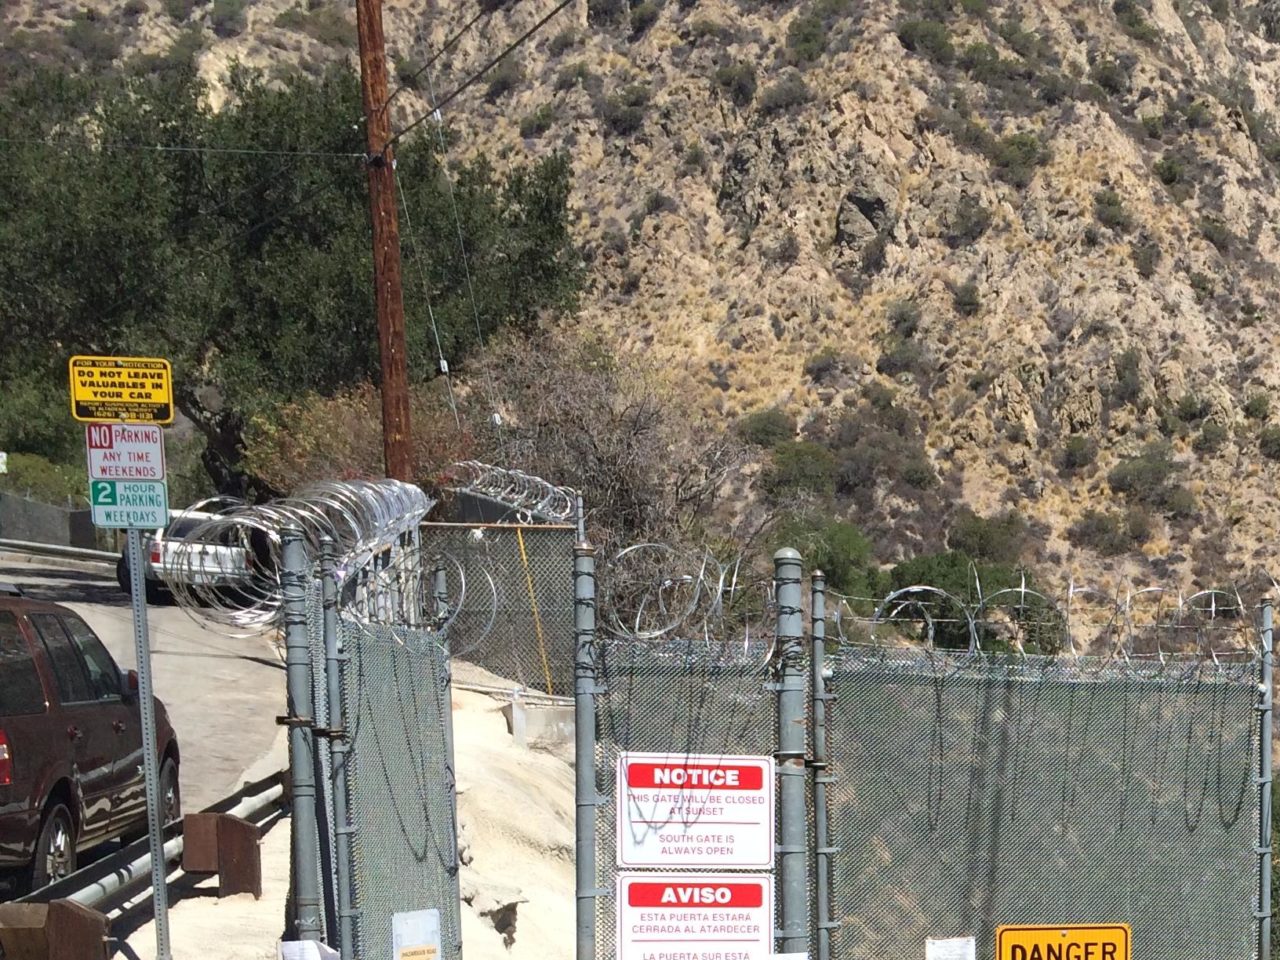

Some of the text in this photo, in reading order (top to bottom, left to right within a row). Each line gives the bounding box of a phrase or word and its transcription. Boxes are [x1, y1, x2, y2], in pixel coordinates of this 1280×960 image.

[78, 370, 94, 378] DO
[80, 381, 146, 389] VALUABLES
[90, 427, 158, 448] NO PARKING
[102, 452, 151, 462] ANY TIME
[100, 466, 156, 477] WEEKENDS
[98, 483, 155, 502] 2 HOUR
[120, 494, 162, 507] PARKING
[104, 510, 157, 523] WEEKDAYS
[654, 768, 740, 786] NOTICE
[628, 794, 765, 804] THIS GATE WILL BE CLOSED
[659, 835, 734, 843] SOUTH GATE IS
[661, 847, 733, 855] ALWAYS OPEN
[661, 888, 732, 903] AVISO
[640, 913, 666, 921] ESTA
[632, 925, 760, 933] CERRADA AL ATARDECER
[643, 953, 656, 960] LA
[659, 953, 699, 960] PUERTA
[701, 953, 722, 960] SUR
